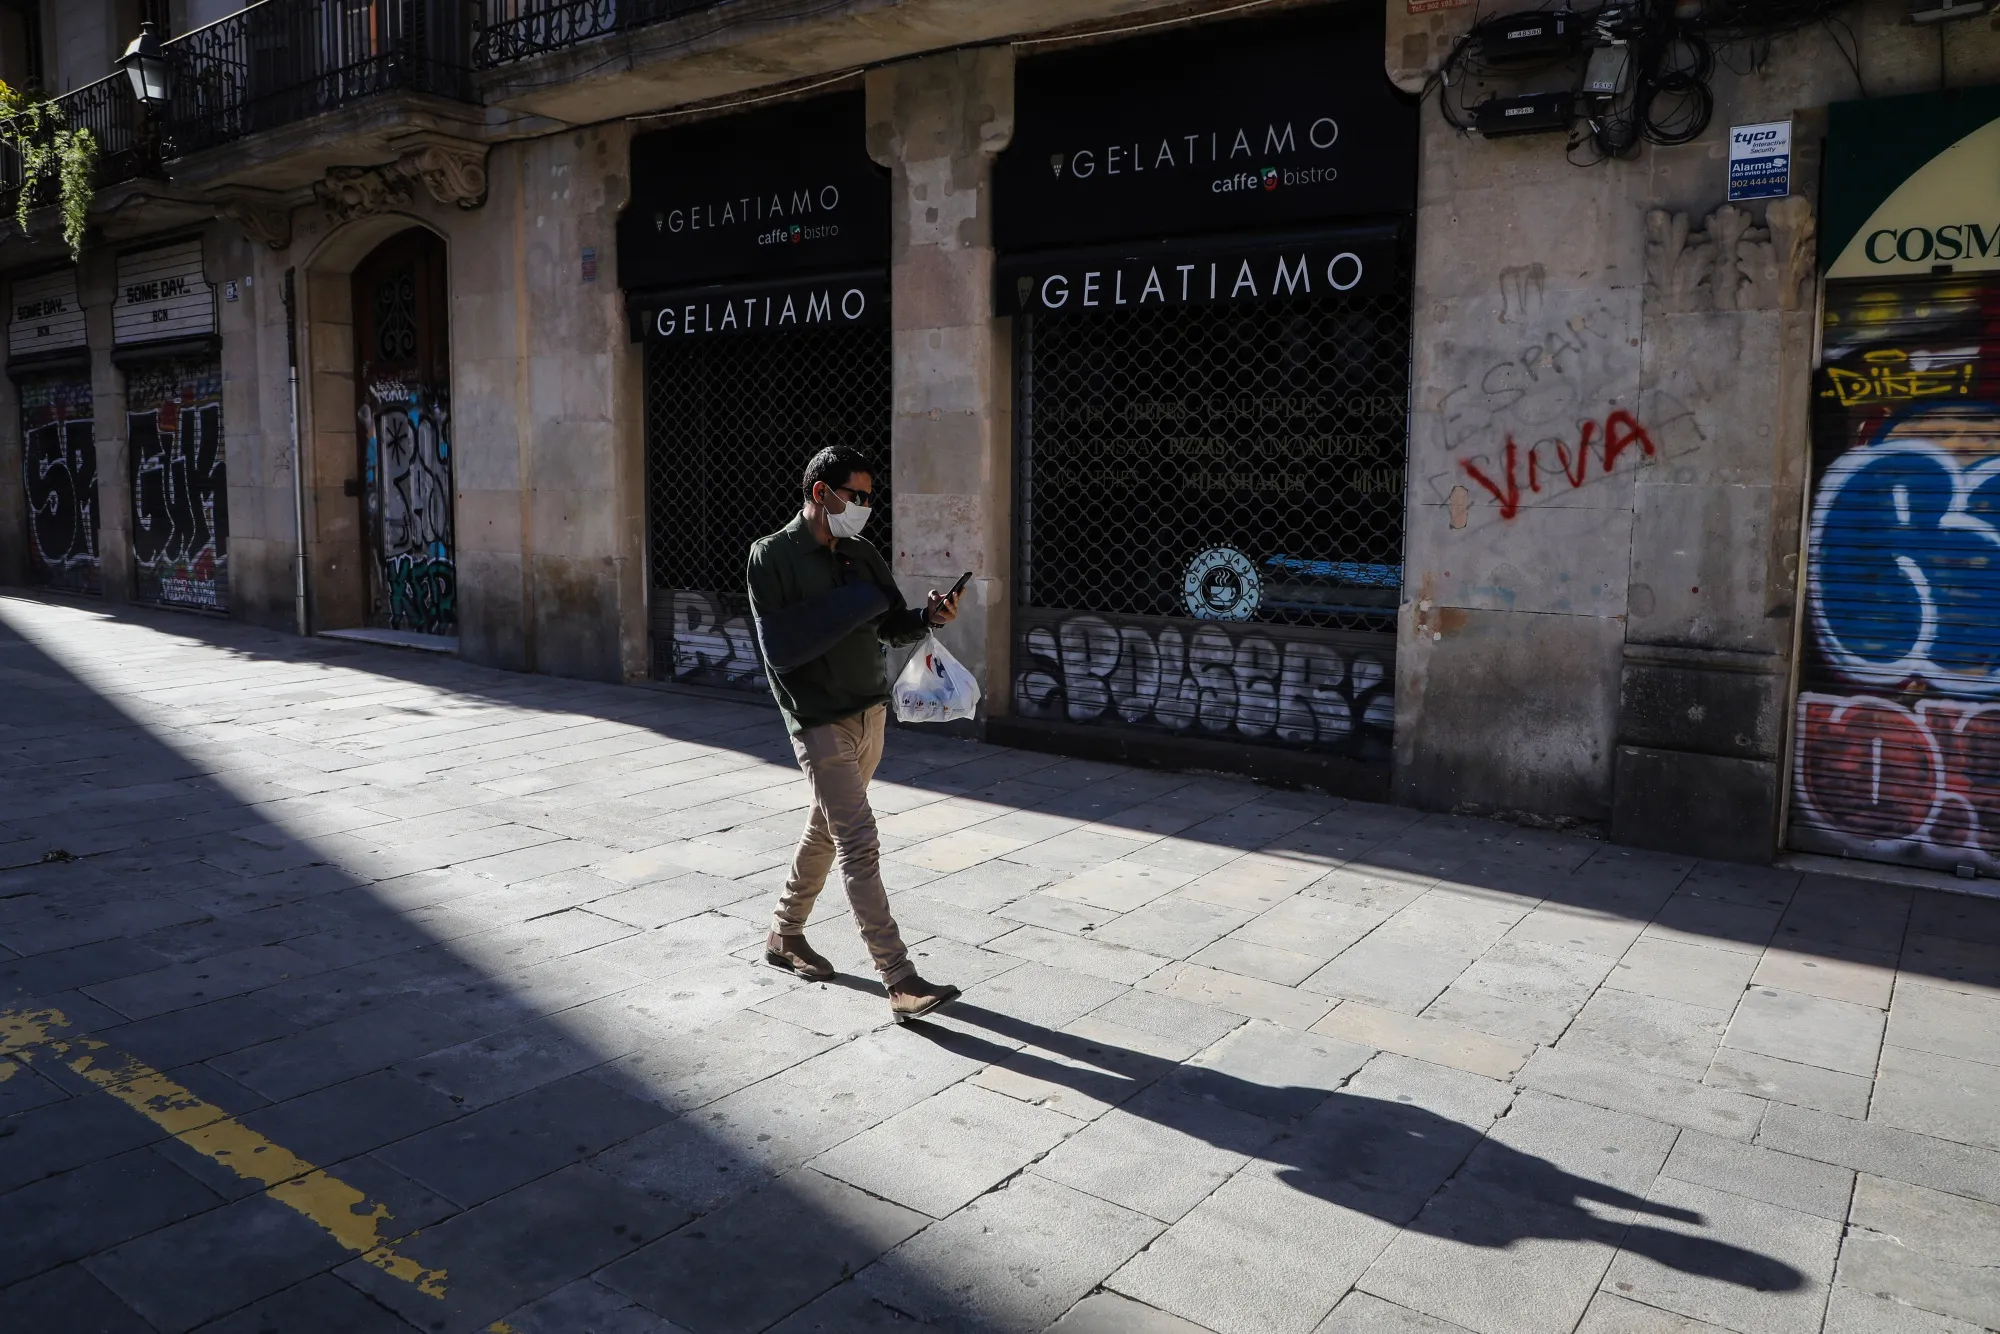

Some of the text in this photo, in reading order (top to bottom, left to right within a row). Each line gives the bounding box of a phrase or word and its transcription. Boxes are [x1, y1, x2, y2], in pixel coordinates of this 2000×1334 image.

[1071, 117, 1339, 179] GELATIAMO
[1734, 131, 1777, 145] tyco
[1753, 139, 1786, 147] Interactive
[1731, 162, 1772, 172] Alarma
[1211, 167, 1338, 193] caffe bistro
[1731, 176, 1787, 188] 902 444 440
[668, 185, 839, 233] GELATIAMO
[758, 223, 839, 245] caffe bistro
[1865, 223, 2000, 264] COSM
[1041, 252, 1363, 309] GELATIAMO
[126, 283, 158, 303] SOME
[18, 301, 42, 320] SOME
[152, 308, 169, 322] BCN
[657, 288, 865, 336] GELATIAMO
[1459, 408, 1658, 520] VIVA
